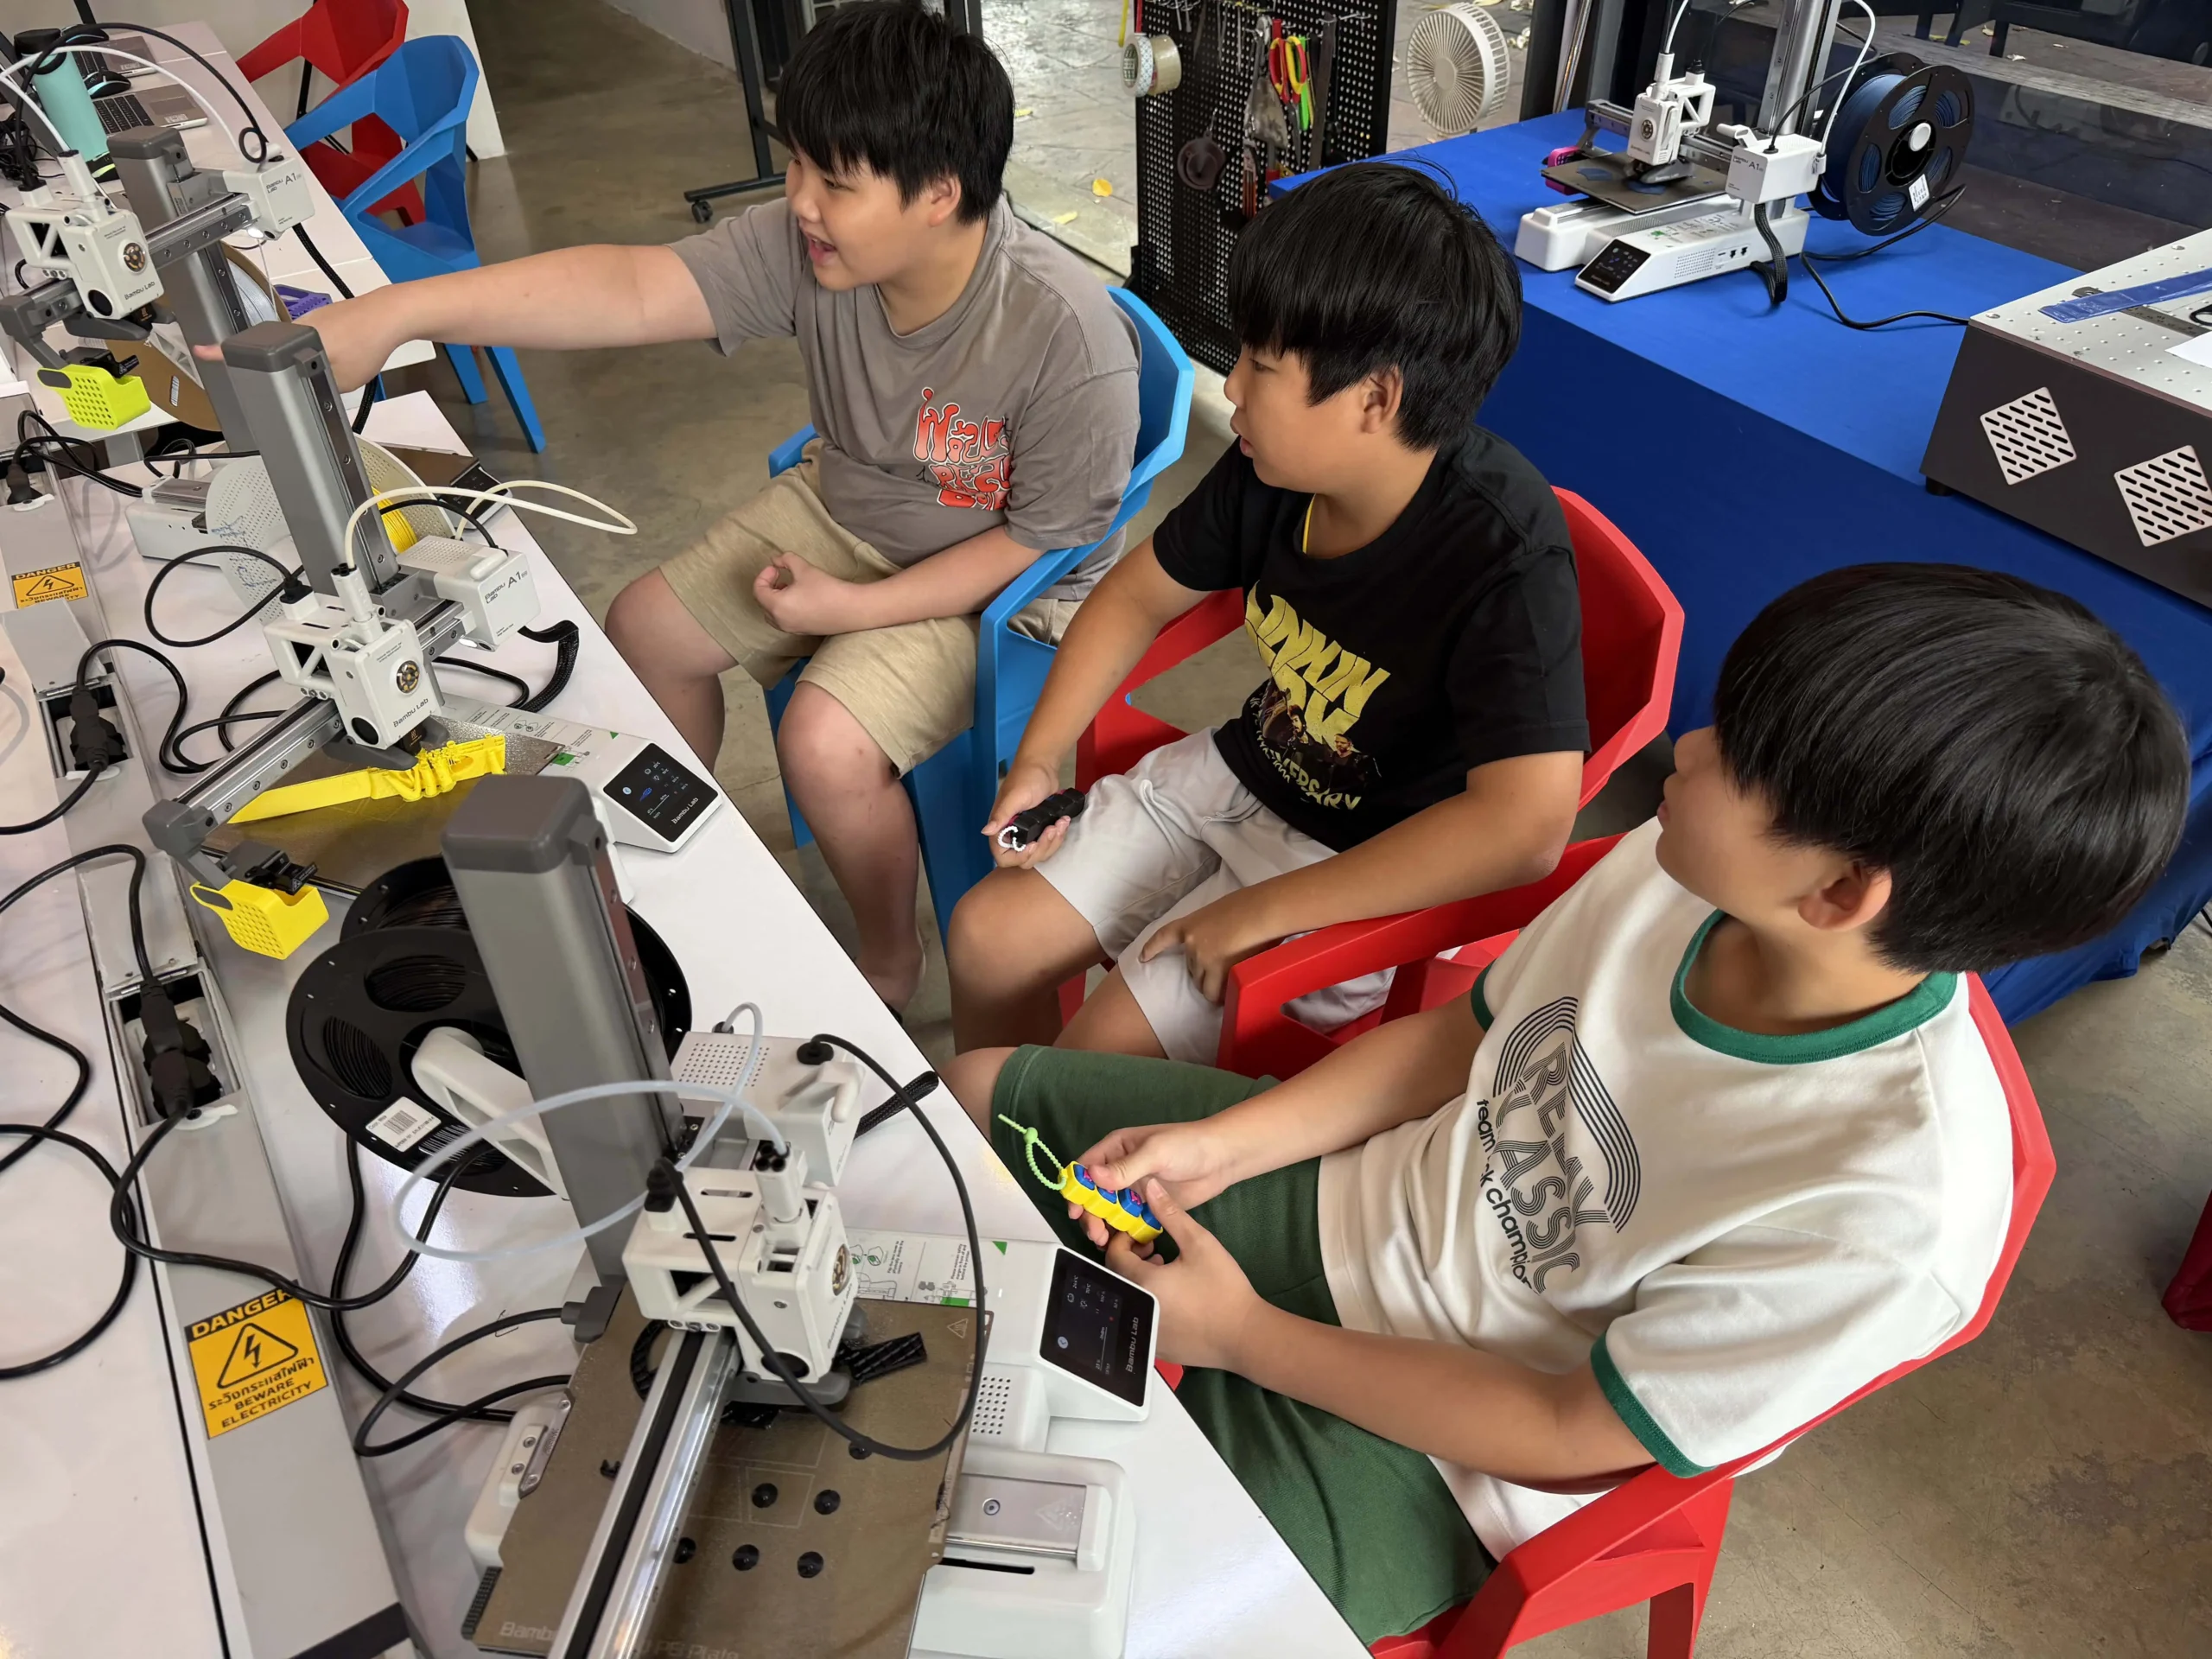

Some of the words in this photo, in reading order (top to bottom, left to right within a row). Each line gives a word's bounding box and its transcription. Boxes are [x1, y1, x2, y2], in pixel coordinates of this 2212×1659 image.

[285, 172, 296, 185] A1
[1749, 162, 1760, 172] A1
[143, 281, 156, 290] Lab
[16, 563, 77, 580] DANGER
[507, 571, 522, 588] A1
[393, 708, 416, 728] Bambu
[416, 698, 429, 710] Lab
[671, 804, 690, 824] Bambu
[689, 797, 699, 809] Lab
[1476, 1098, 1497, 1152] team
[1130, 1317, 1139, 1336] Lab
[1125, 1337, 1137, 1372] Bambu
[221, 1381, 312, 1427] ELECTRICITY
[234, 1378, 294, 1410] BEWARE
